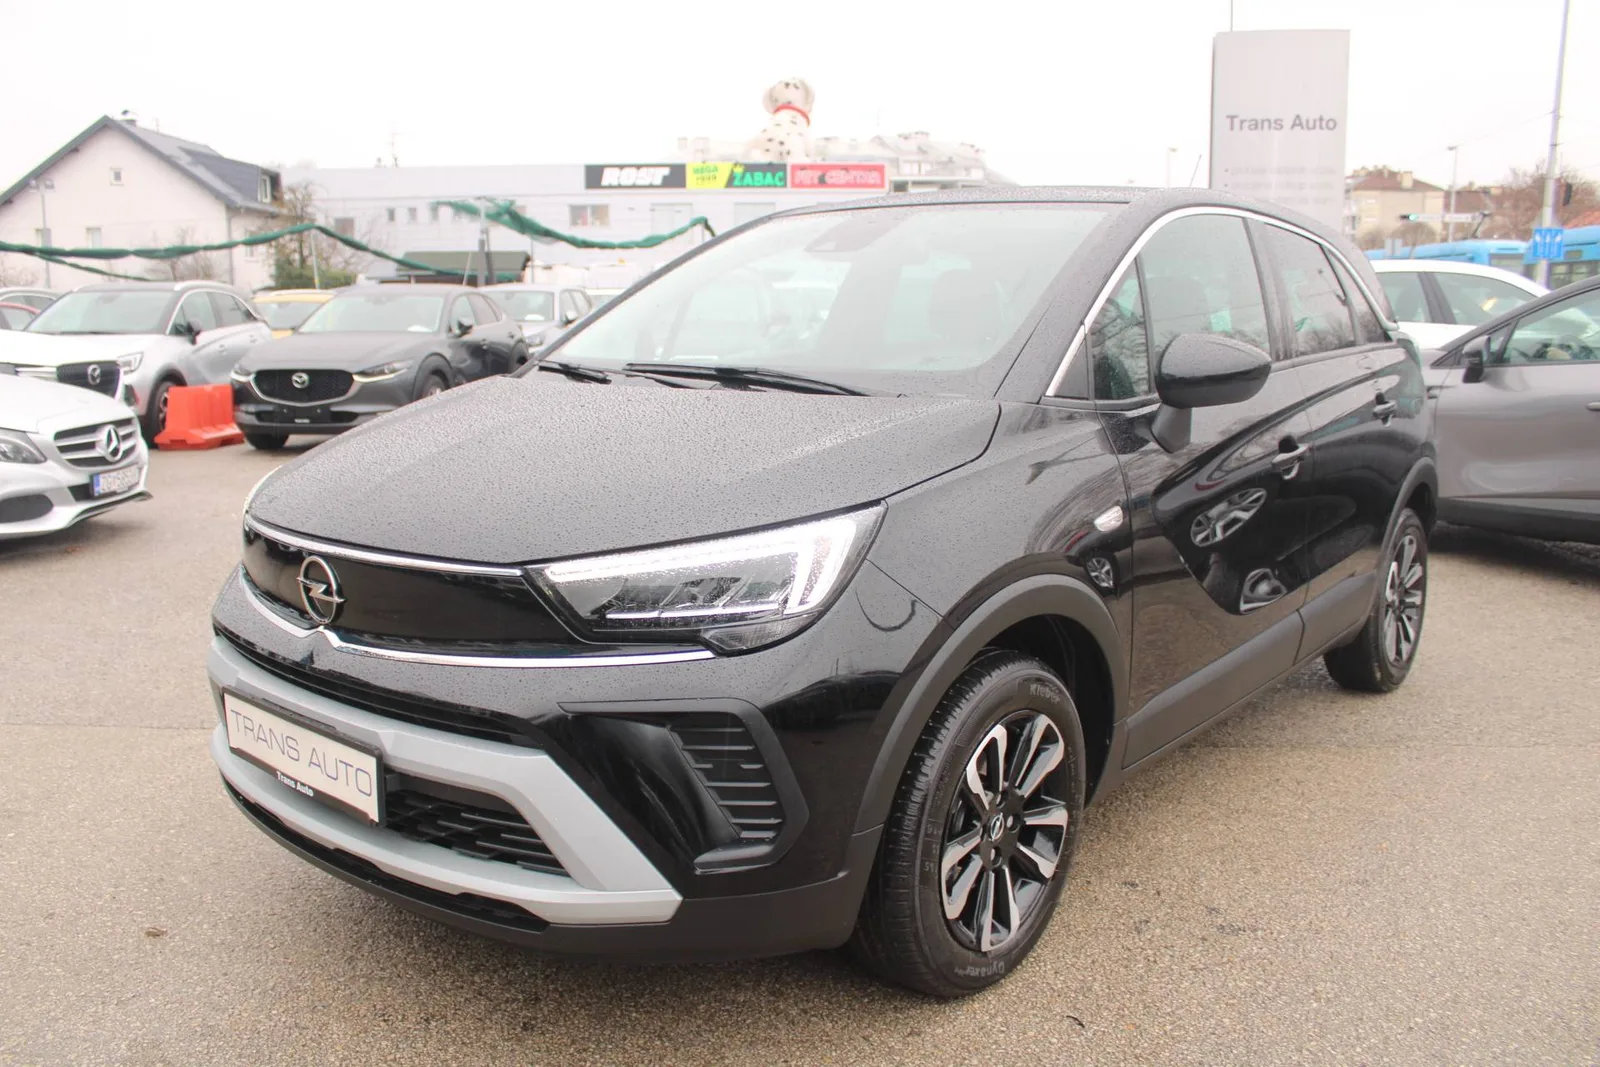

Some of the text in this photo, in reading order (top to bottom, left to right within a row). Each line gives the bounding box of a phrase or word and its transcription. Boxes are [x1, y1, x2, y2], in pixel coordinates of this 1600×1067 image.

[1226, 114, 1338, 131] Trans Auto
[230, 709, 373, 798] TRANS AUTO
[275, 770, 315, 798] Trans Auto
